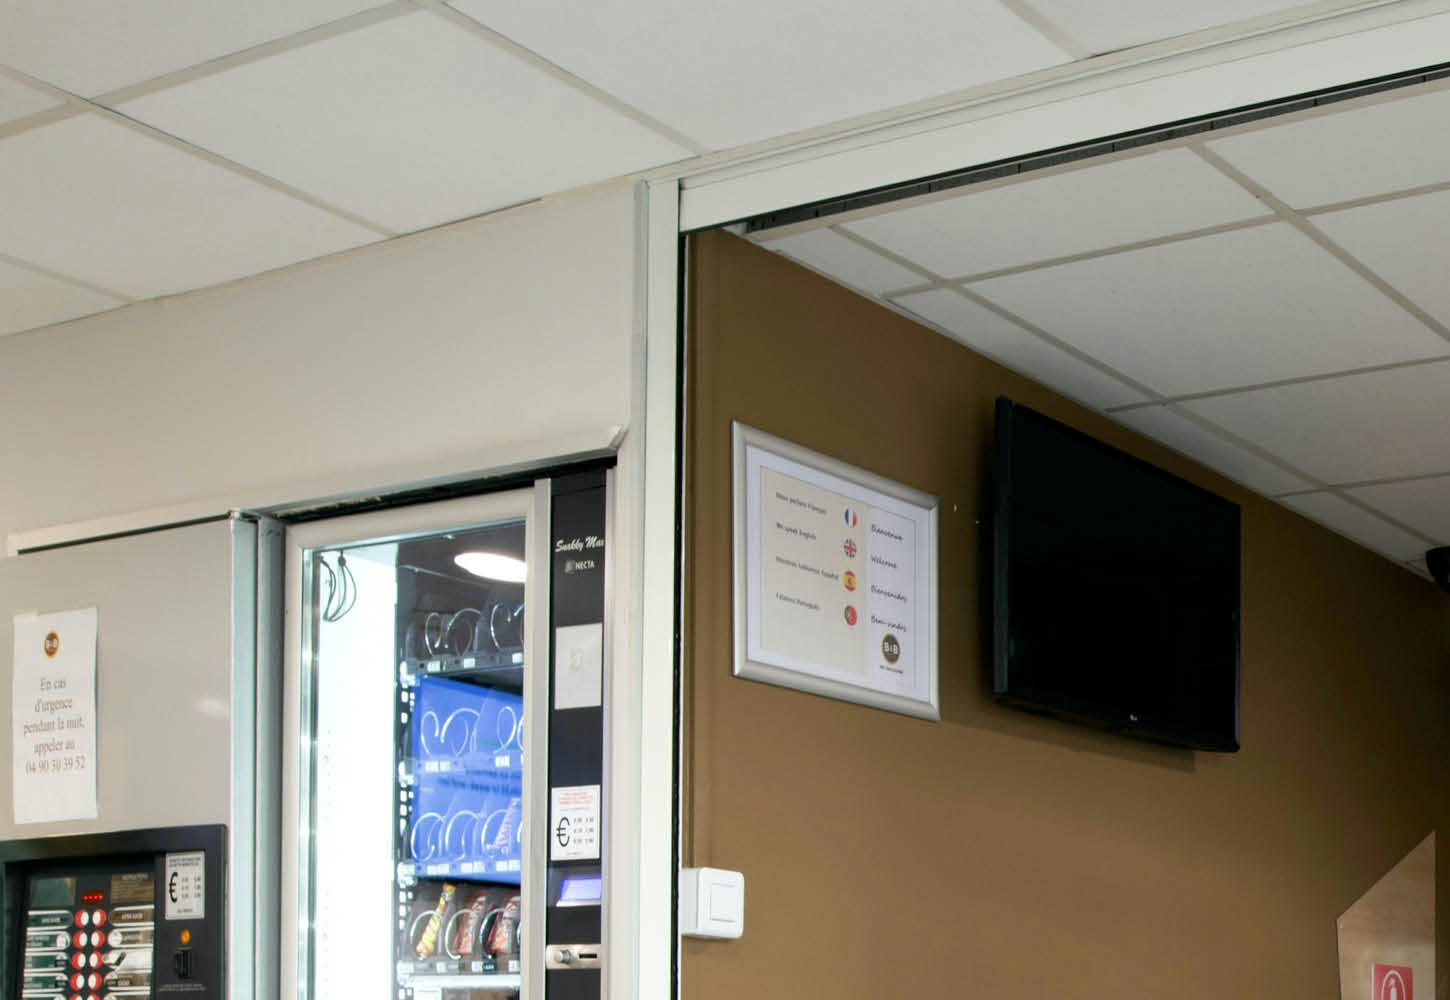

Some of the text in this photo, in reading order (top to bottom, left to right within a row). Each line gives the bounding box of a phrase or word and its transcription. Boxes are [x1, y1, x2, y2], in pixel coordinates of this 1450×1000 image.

[575, 560, 595, 570] NECTA
[40, 678, 67, 691] En cas
[34, 697, 73, 715] d'urgence
[24, 718, 56, 738] pendant
[34, 737, 63, 757] appeler
[25, 755, 88, 774] 04 90 30 39 52
